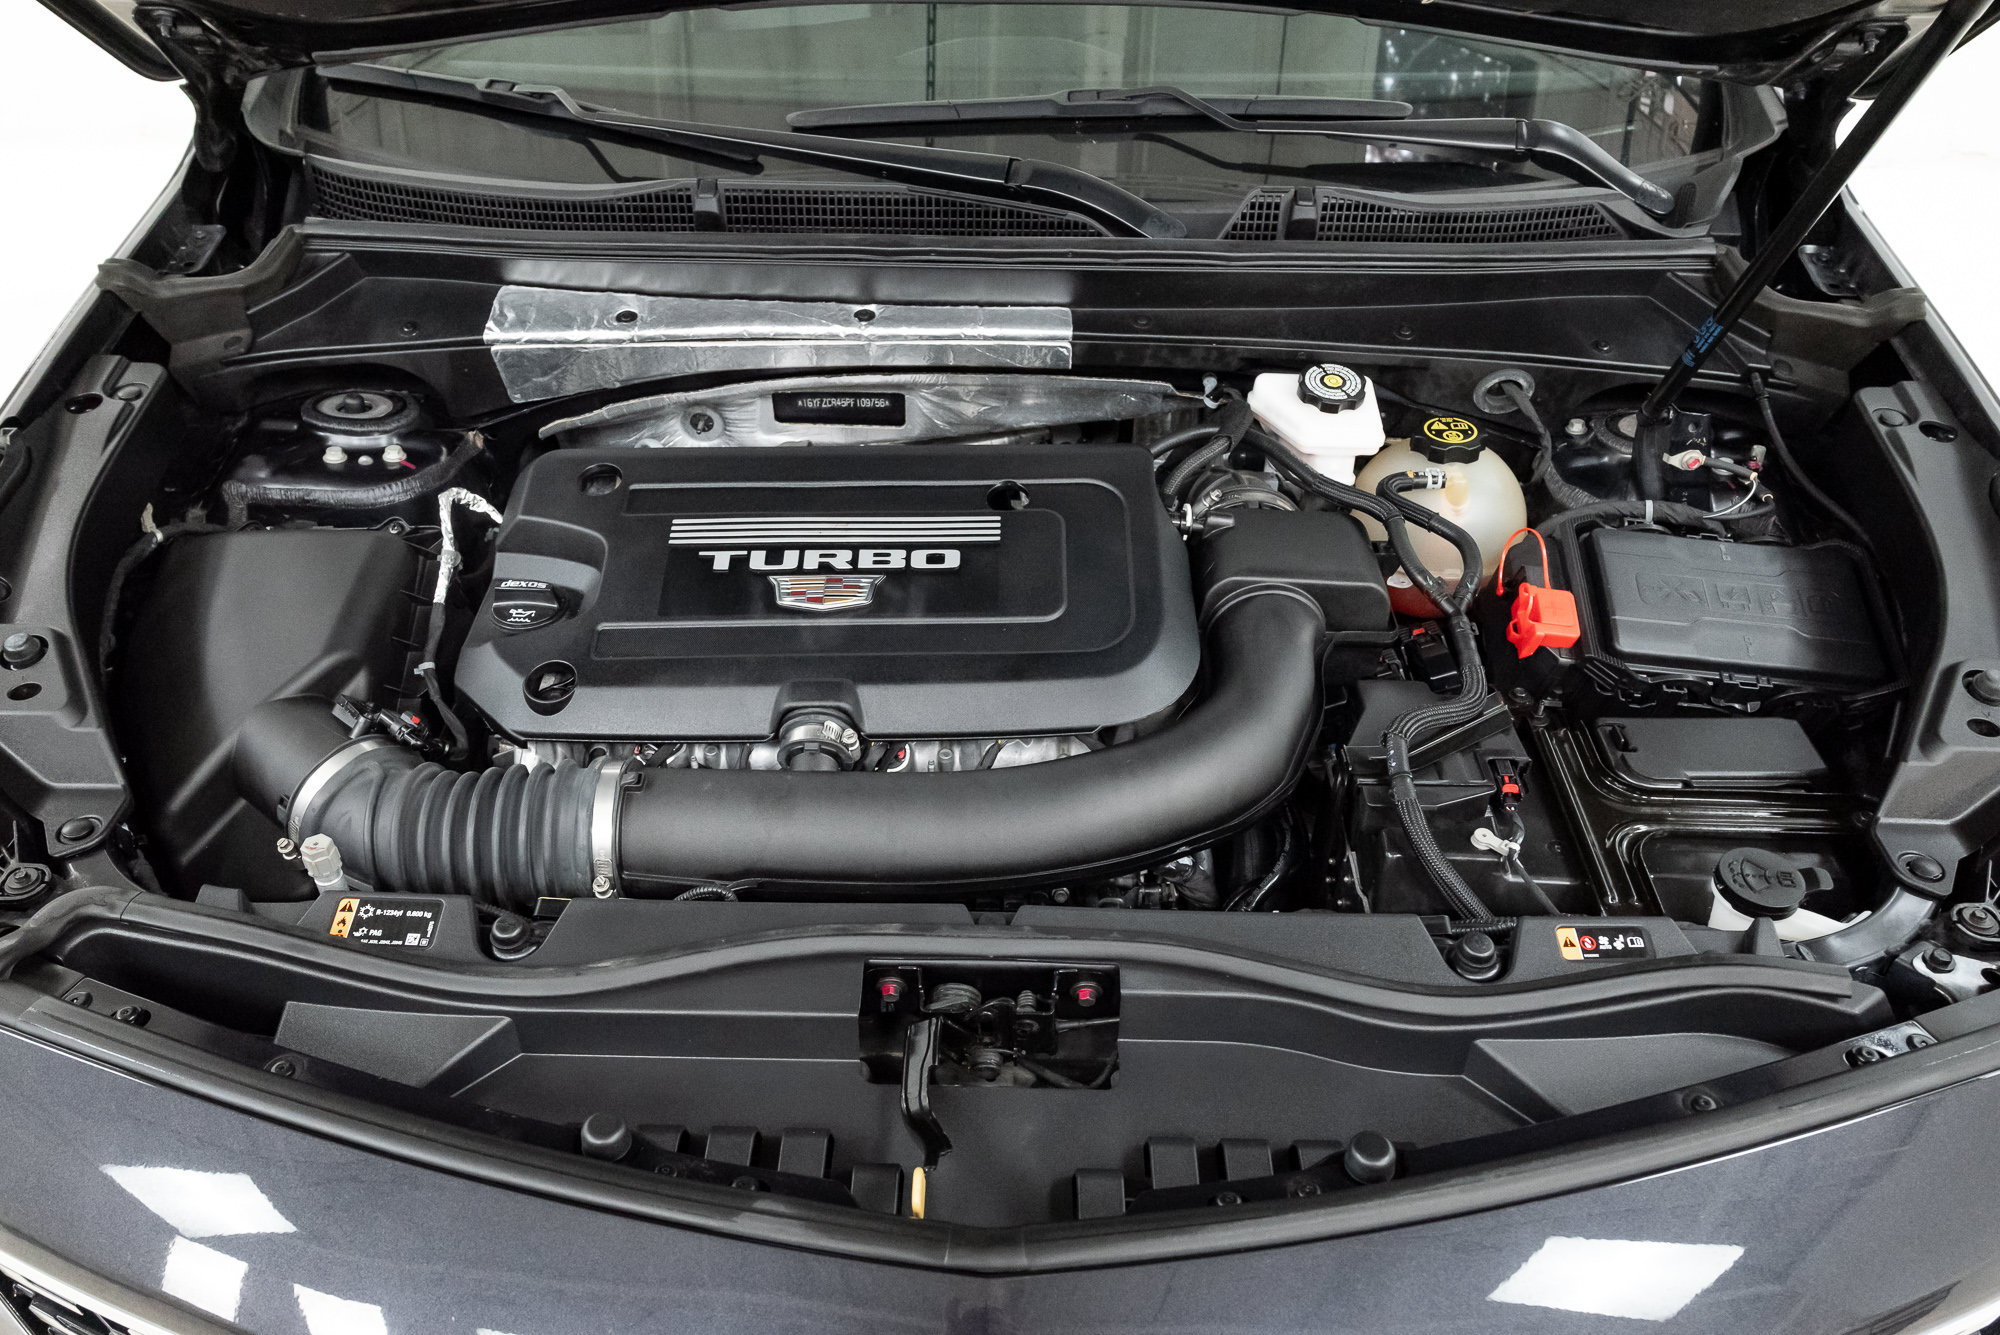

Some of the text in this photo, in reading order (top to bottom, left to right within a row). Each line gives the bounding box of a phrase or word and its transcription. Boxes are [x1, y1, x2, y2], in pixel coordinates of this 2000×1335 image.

[699, 549, 961, 571] TURBO
[501, 580, 548, 588] dexos
[375, 909, 403, 917] R-1234yf
[423, 911, 432, 919] kg
